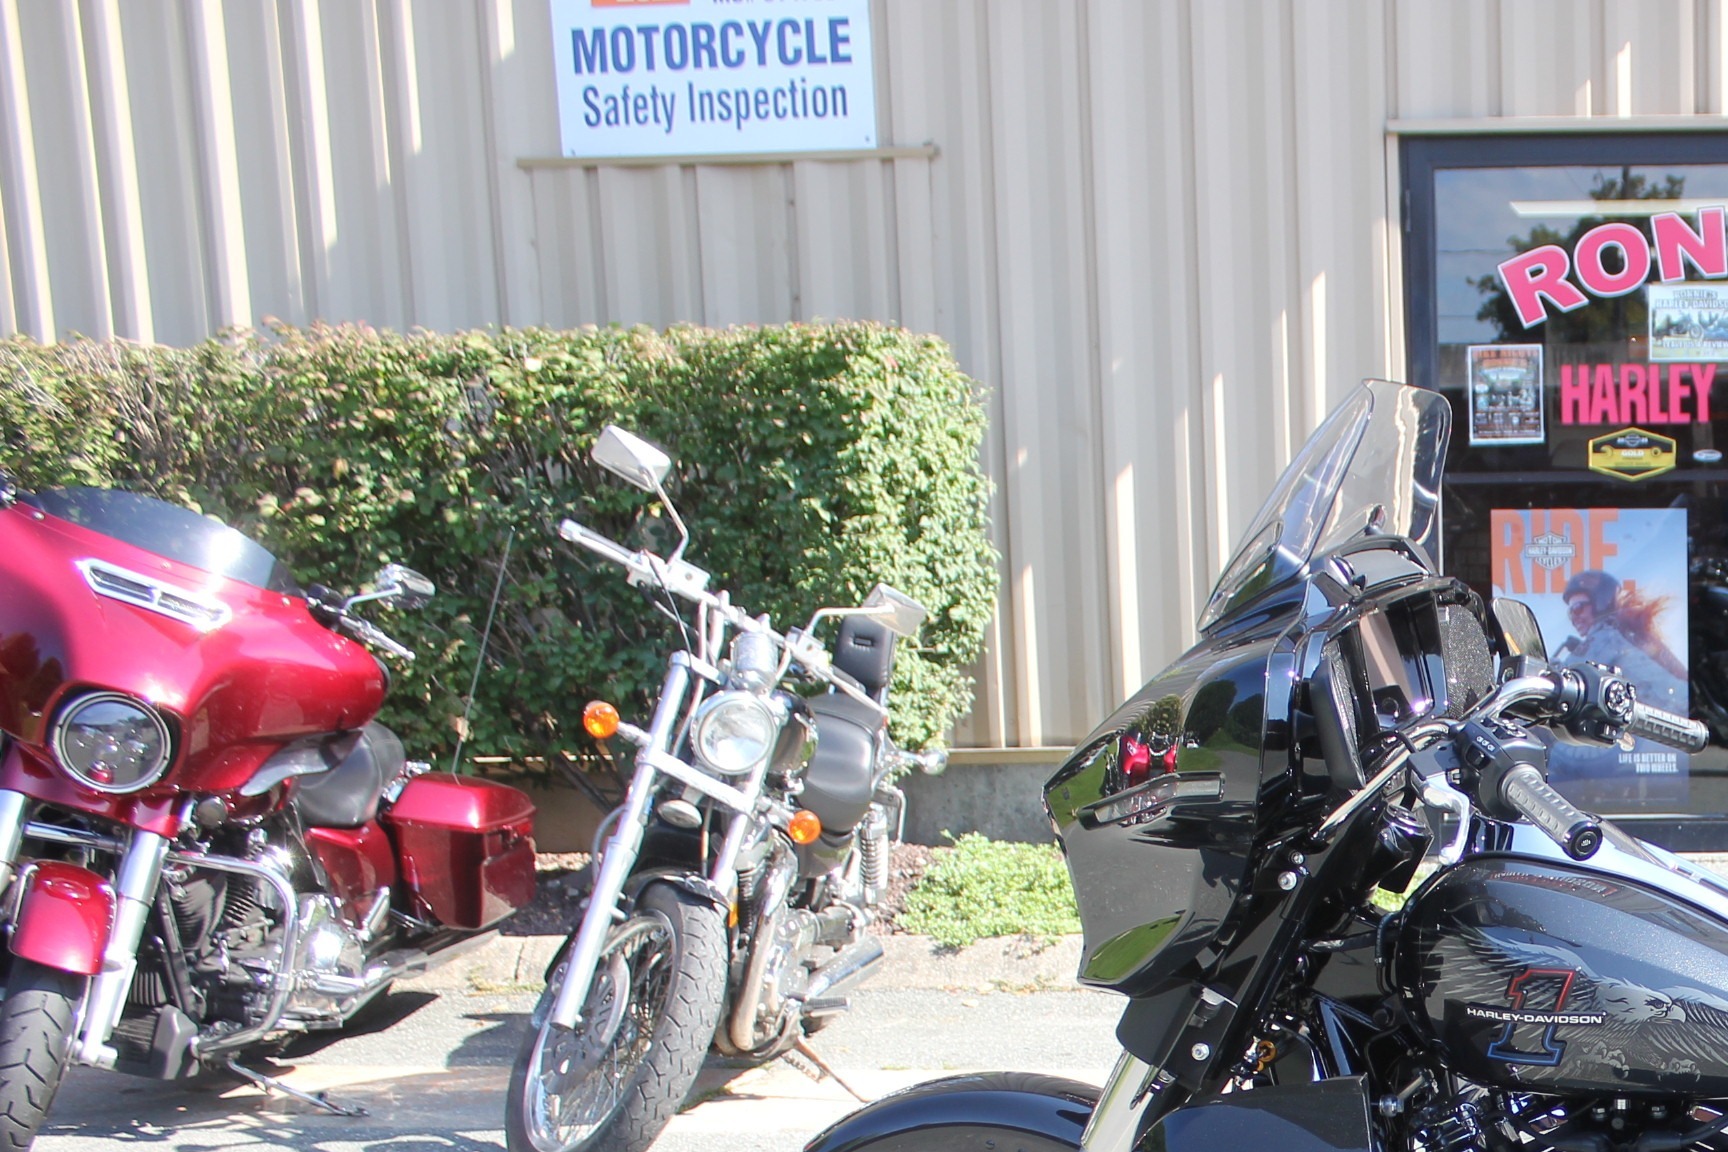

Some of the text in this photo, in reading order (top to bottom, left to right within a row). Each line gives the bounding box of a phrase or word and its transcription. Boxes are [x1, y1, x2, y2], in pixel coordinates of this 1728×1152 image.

[571, 16, 853, 75] MOTORCYCLE
[583, 77, 849, 134] Safety Inspection
[1498, 206, 1728, 328] RON
[1560, 362, 1717, 424] HARLEY
[1621, 449, 1645, 458] GOLD
[1618, 753, 1632, 764] LIFE
[1641, 753, 1666, 763] BETTER
[1667, 753, 1677, 762] ON
[1636, 763, 1679, 773] TWO WHEELS.
[1467, 1007, 1603, 1024] HARLEY-DAVIDSON
